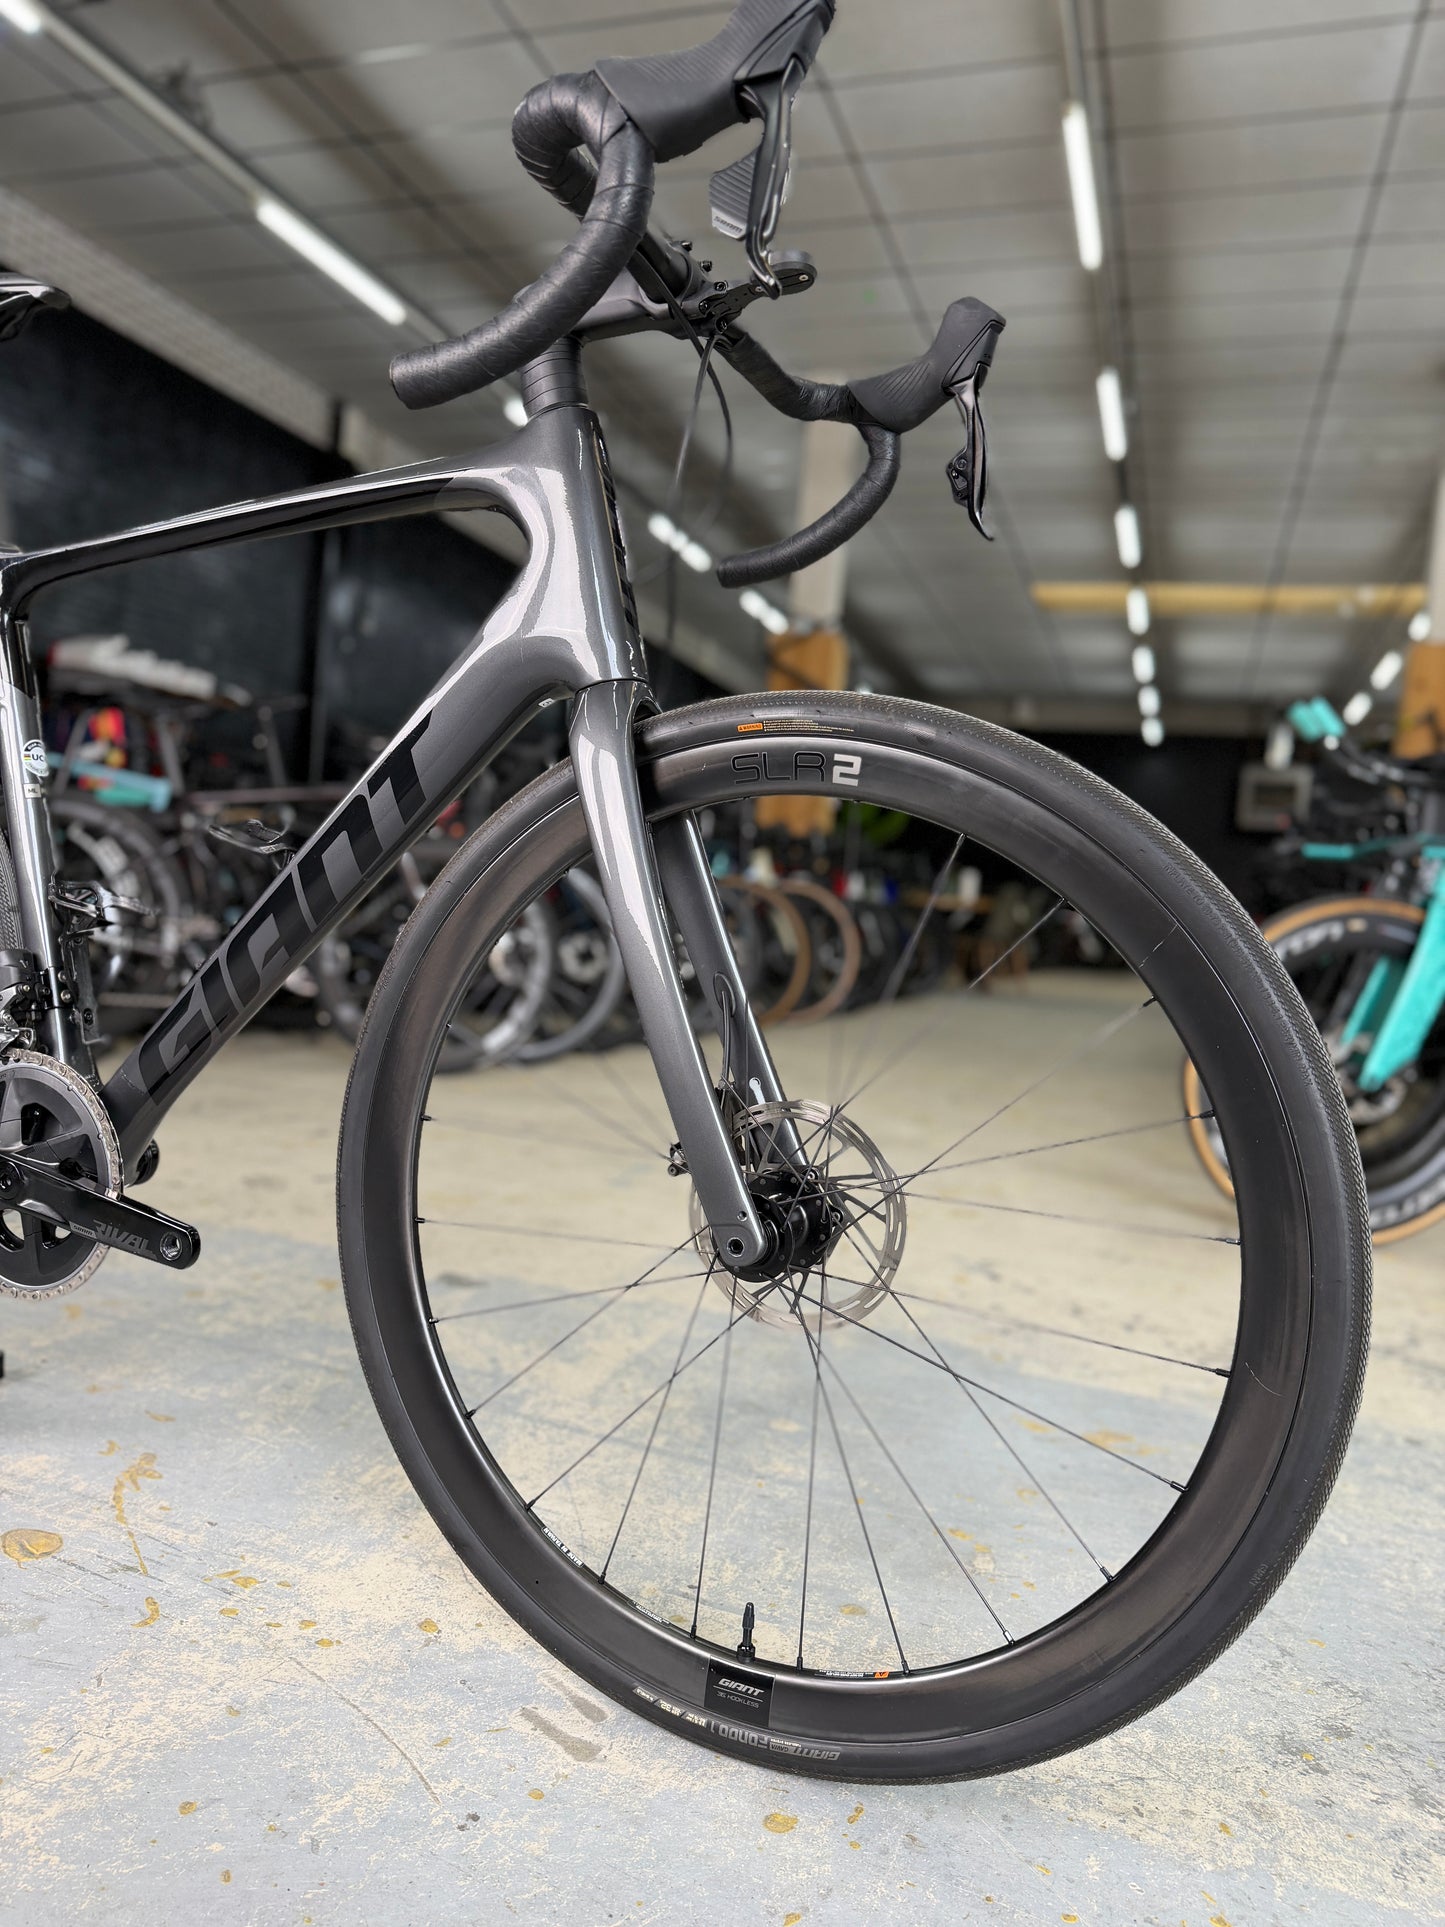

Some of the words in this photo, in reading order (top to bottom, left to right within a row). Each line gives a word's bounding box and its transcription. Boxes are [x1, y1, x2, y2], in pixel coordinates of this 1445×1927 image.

[731, 751, 826, 784] SLR
[832, 753, 862, 786] 2
[138, 709, 433, 1106] GIANT
[93, 1219, 158, 1261] RIVAL
[718, 1678, 765, 1696] GIANT
[718, 1723, 769, 1749] FONDO
[793, 1747, 841, 1761] GIANT
